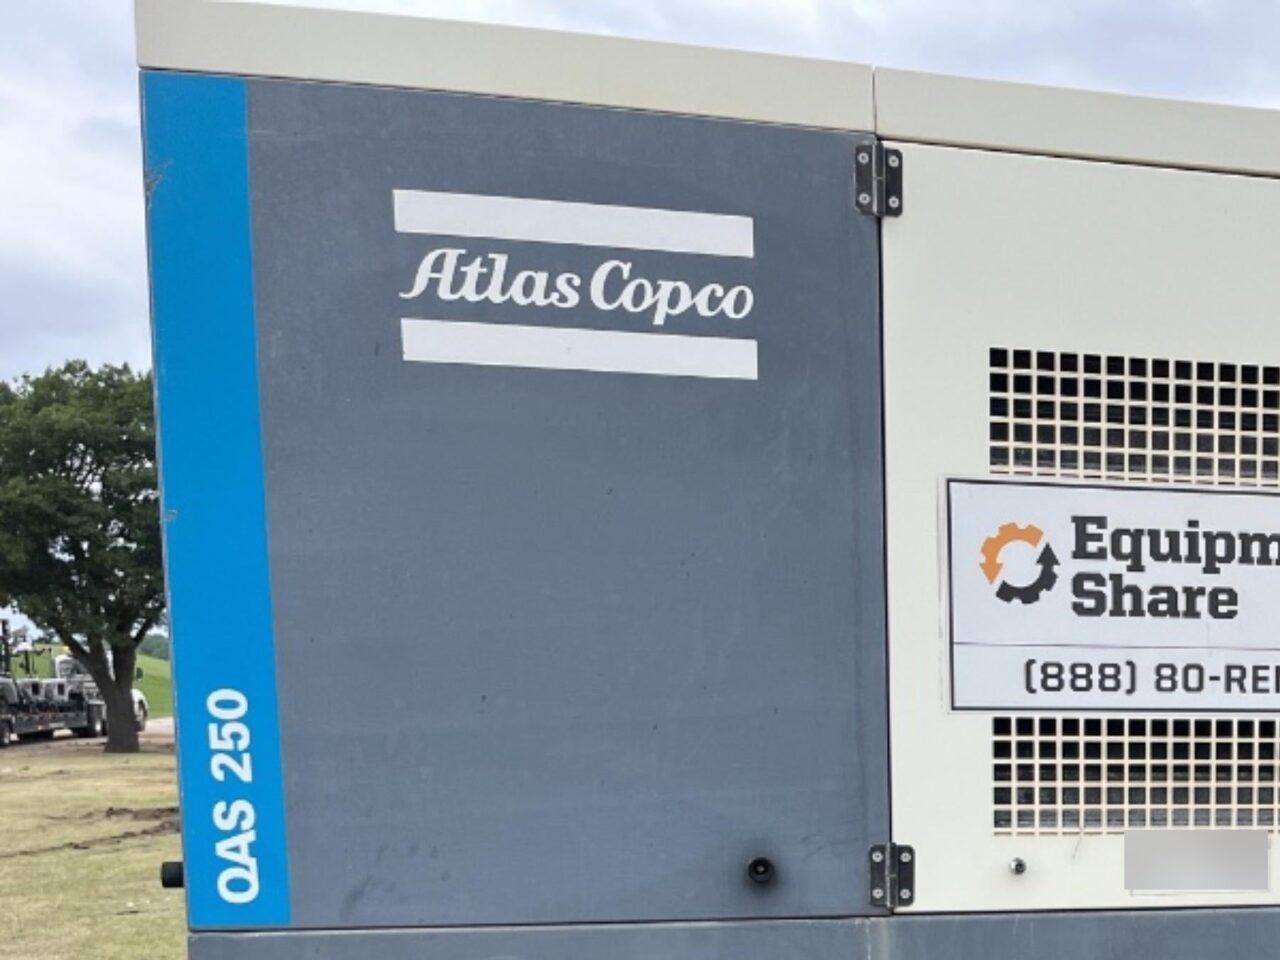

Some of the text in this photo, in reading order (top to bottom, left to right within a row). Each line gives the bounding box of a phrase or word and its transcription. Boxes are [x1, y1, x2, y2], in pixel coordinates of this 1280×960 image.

[399, 247, 754, 326] Atlas Copco
[1071, 572, 1239, 619] Share
[1024, 659, 1137, 695] (888)
[206, 688, 260, 904] QAS 250
